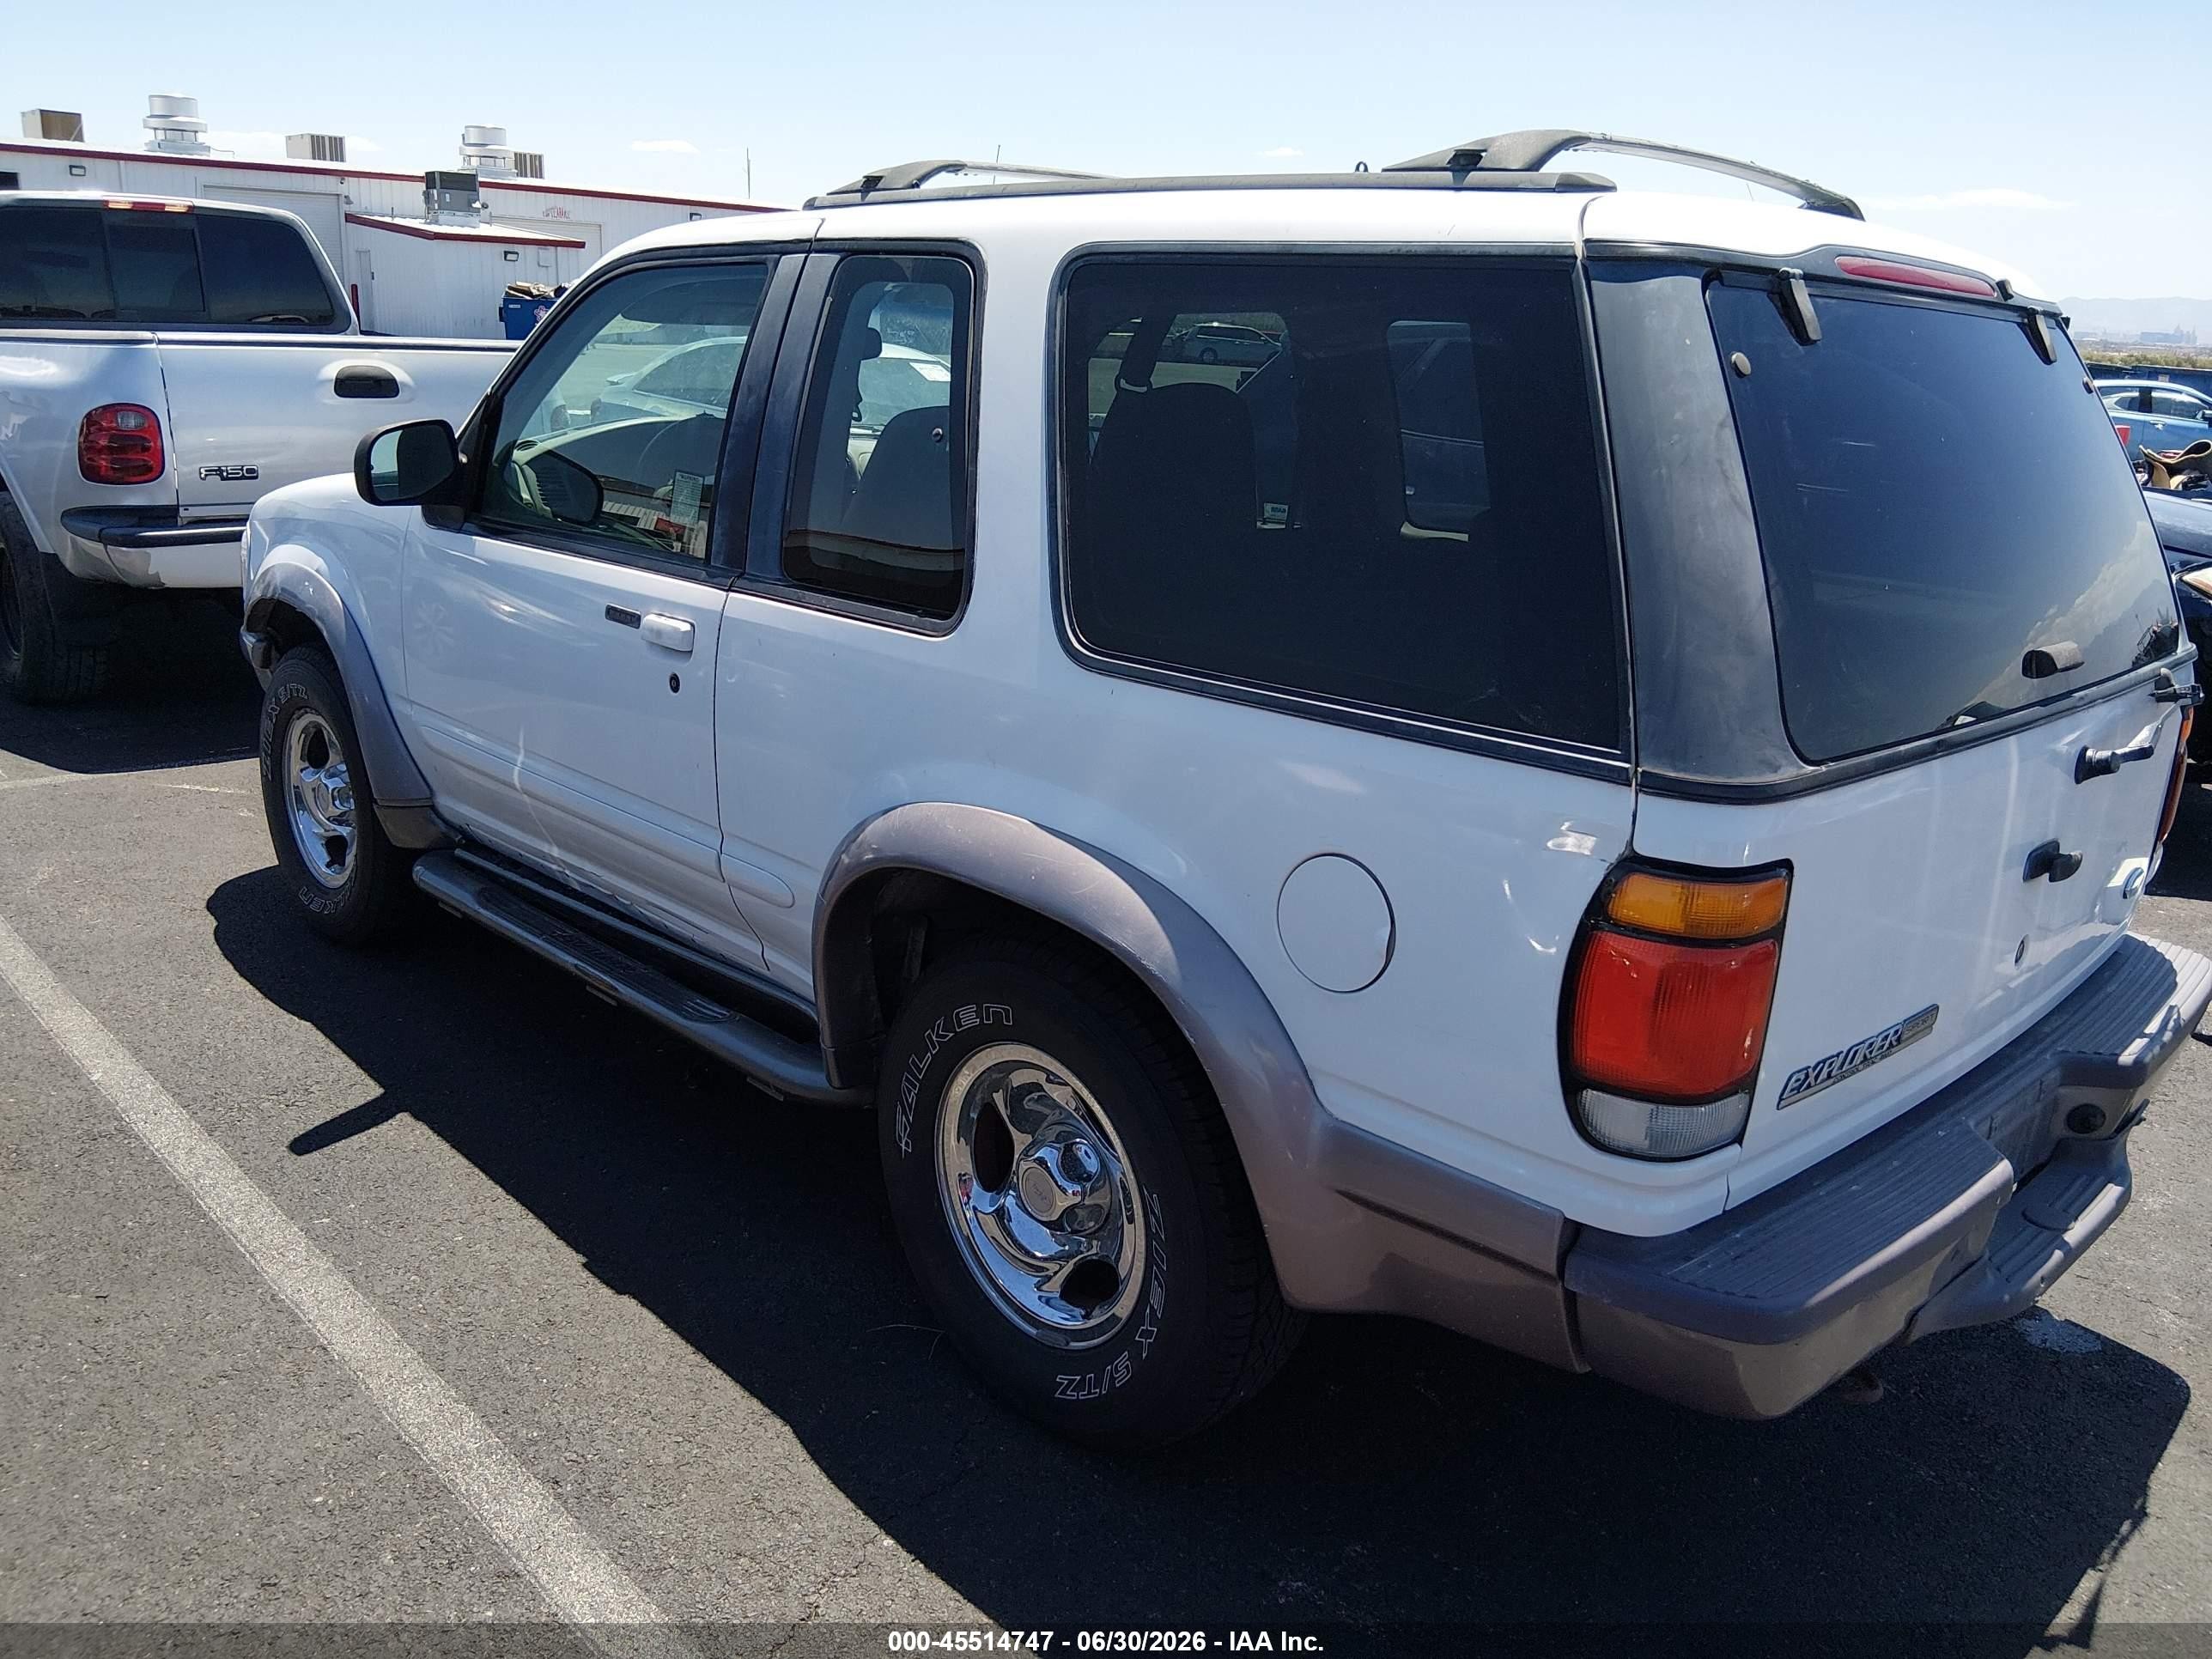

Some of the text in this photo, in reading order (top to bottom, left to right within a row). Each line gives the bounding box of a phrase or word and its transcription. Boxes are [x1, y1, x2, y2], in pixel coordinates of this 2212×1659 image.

[896, 1003, 1013, 1158] FALKEN
[1783, 1024, 1903, 1100] EXPLORER
[1054, 1183, 1167, 1400] ZIEX S/TZ
